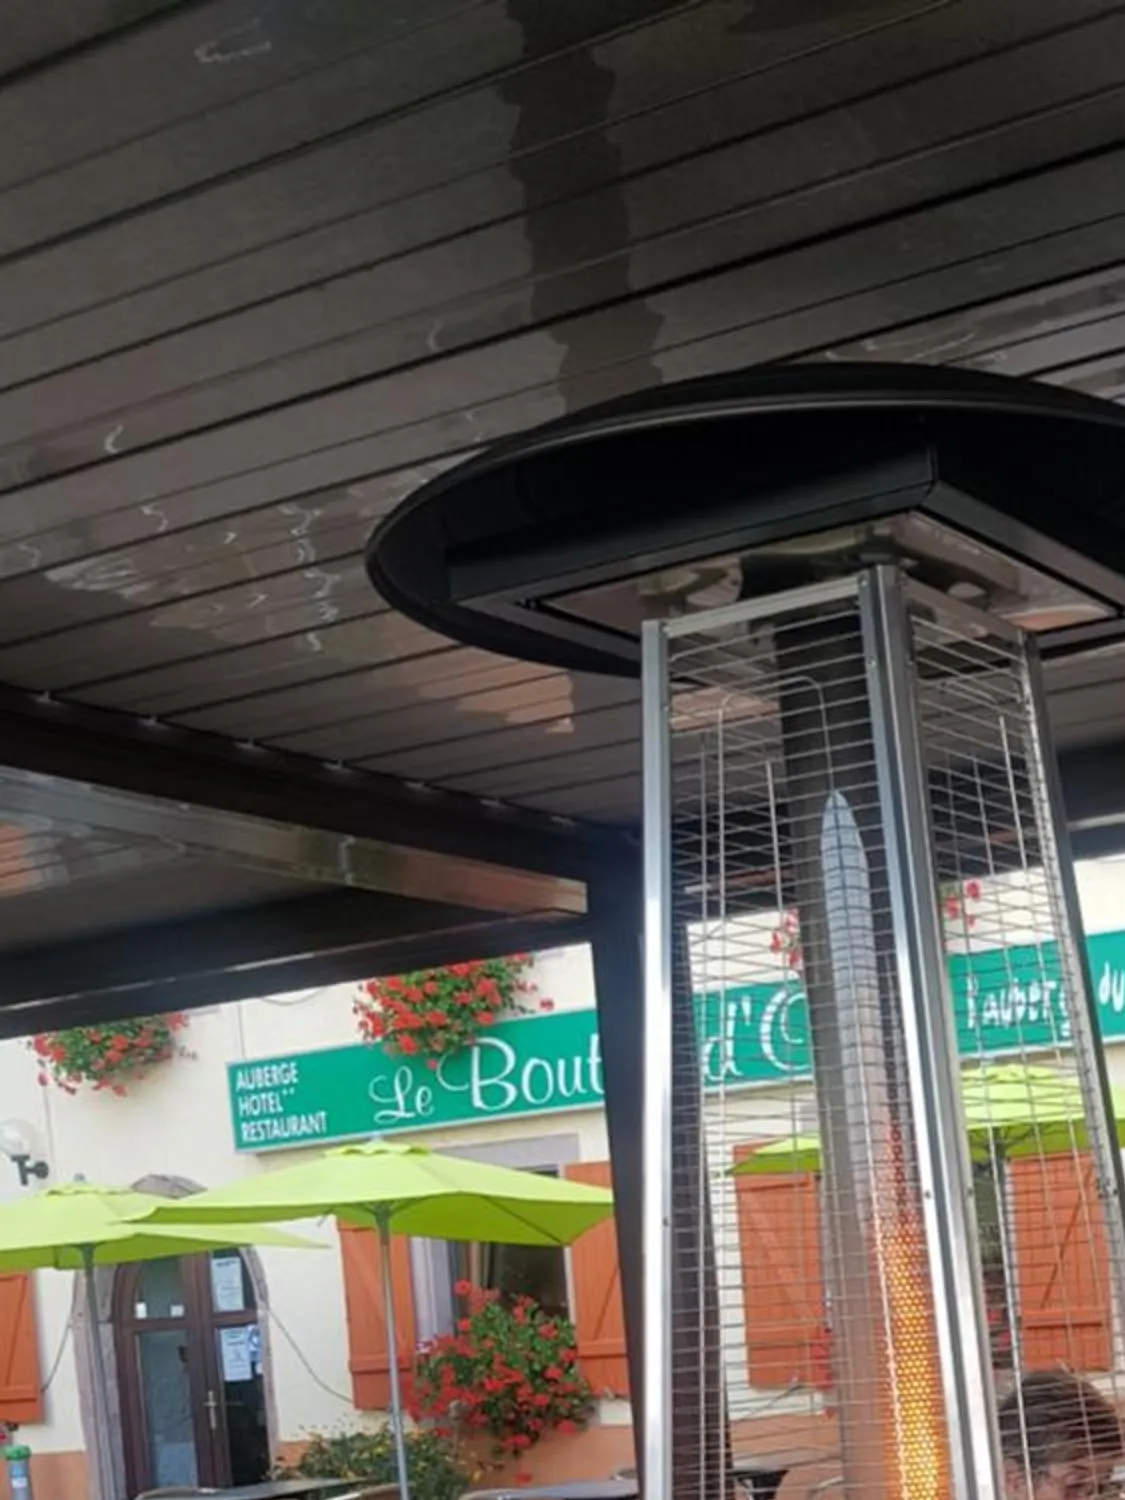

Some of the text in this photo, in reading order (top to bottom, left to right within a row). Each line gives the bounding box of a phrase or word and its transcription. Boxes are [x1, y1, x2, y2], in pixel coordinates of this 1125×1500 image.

[1099, 961, 1125, 1012] du
[236, 1061, 298, 1092] AUBERGE
[368, 1066, 434, 1123] Le
[436, 1034, 605, 1111] Bout
[241, 1110, 327, 1142] RESTAURANT
